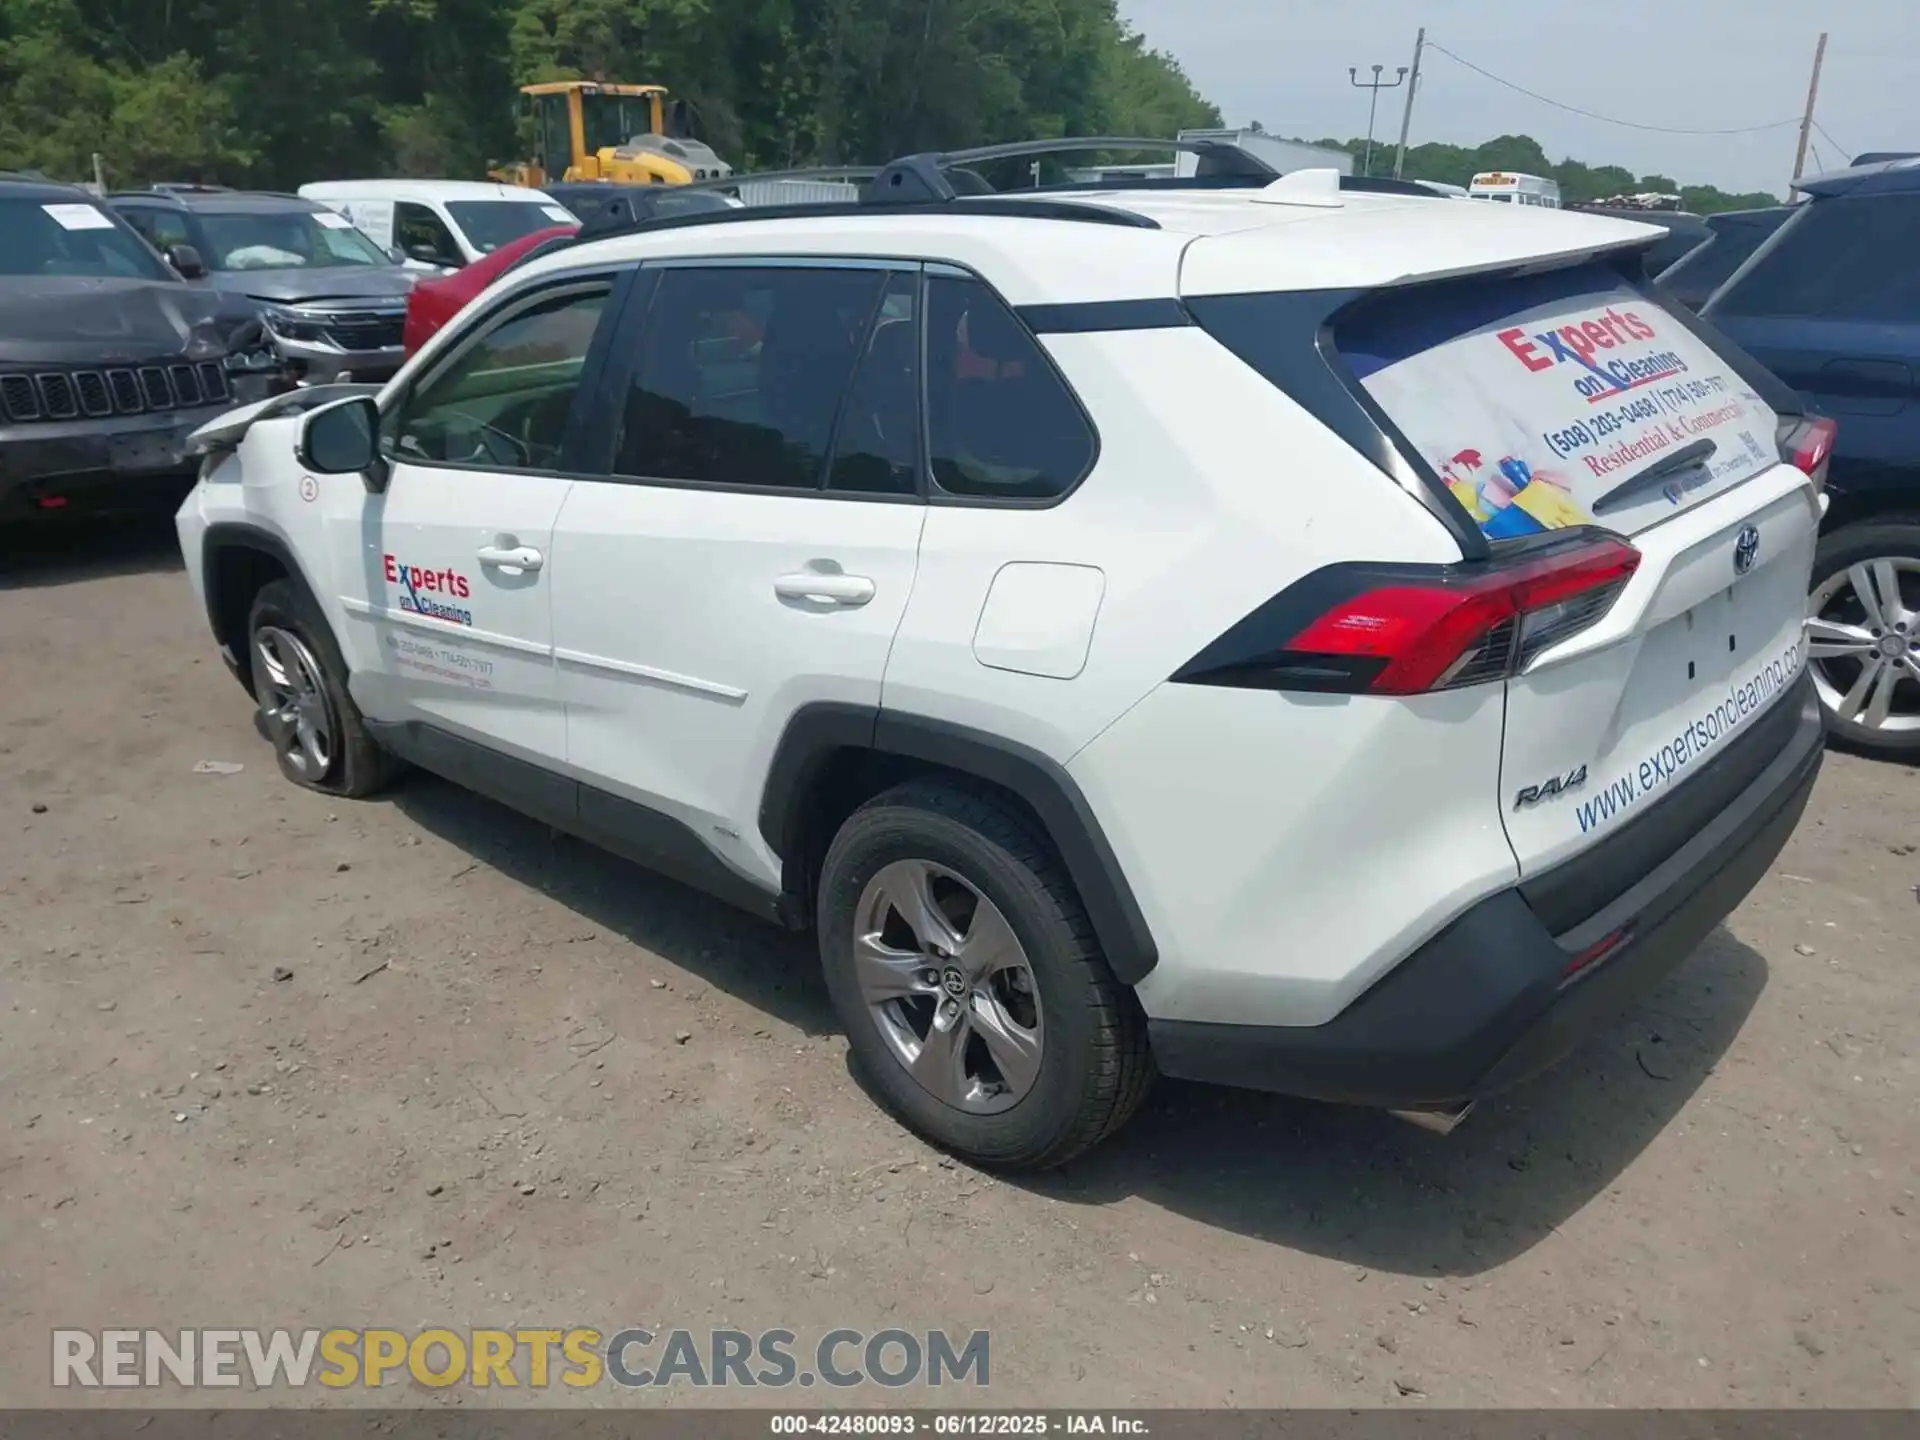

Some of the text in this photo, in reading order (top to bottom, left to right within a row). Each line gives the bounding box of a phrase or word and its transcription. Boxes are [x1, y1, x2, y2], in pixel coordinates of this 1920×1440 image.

[1496, 307, 1656, 372] Experts
[1574, 350, 1688, 397] on Cleaning
[1543, 419, 1599, 460] (508)
[1583, 425, 1671, 477] Residential
[1665, 420, 1685, 441] &
[384, 553, 470, 598] Experts
[421, 596, 473, 627] Cleaning
[1513, 764, 1587, 812] RAV4
